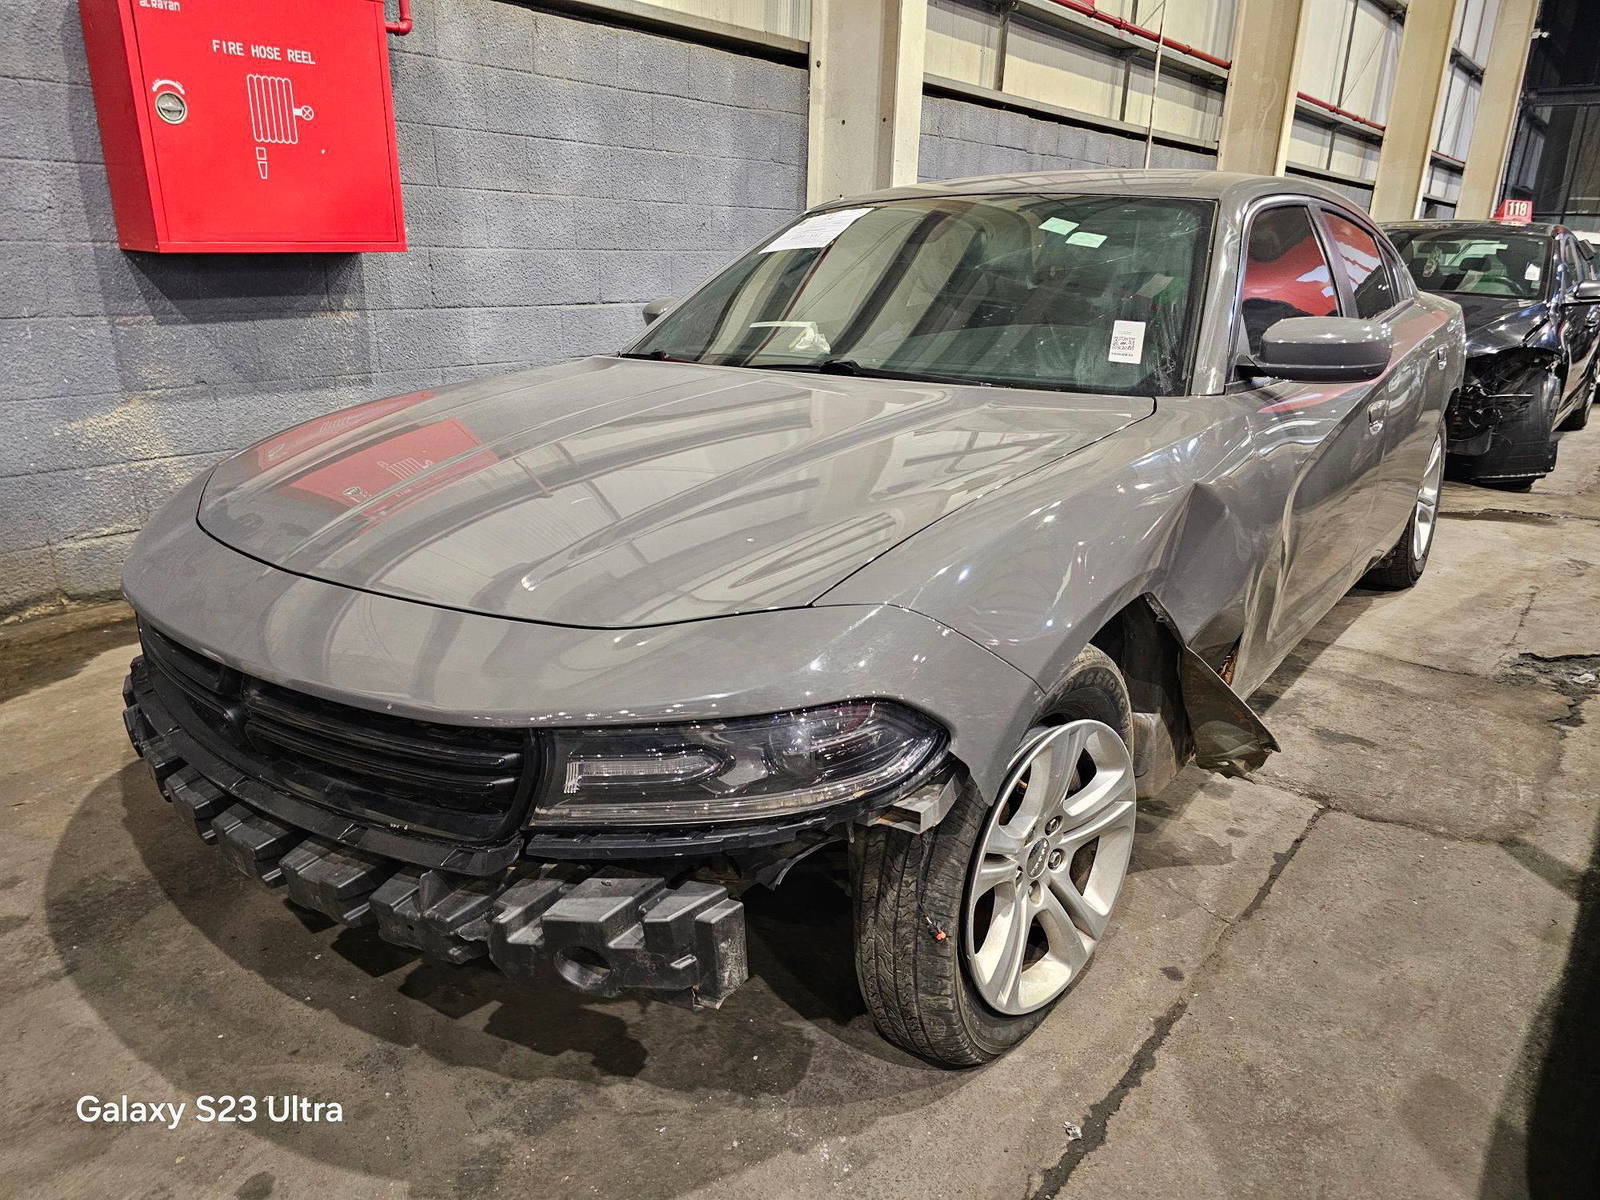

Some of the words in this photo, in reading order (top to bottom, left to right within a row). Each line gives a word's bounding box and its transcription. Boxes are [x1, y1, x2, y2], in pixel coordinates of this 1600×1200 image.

[212, 39, 245, 56] FIRE
[250, 44, 282, 61] HOSE
[287, 48, 317, 65] REEL
[1508, 201, 1528, 217] 118
